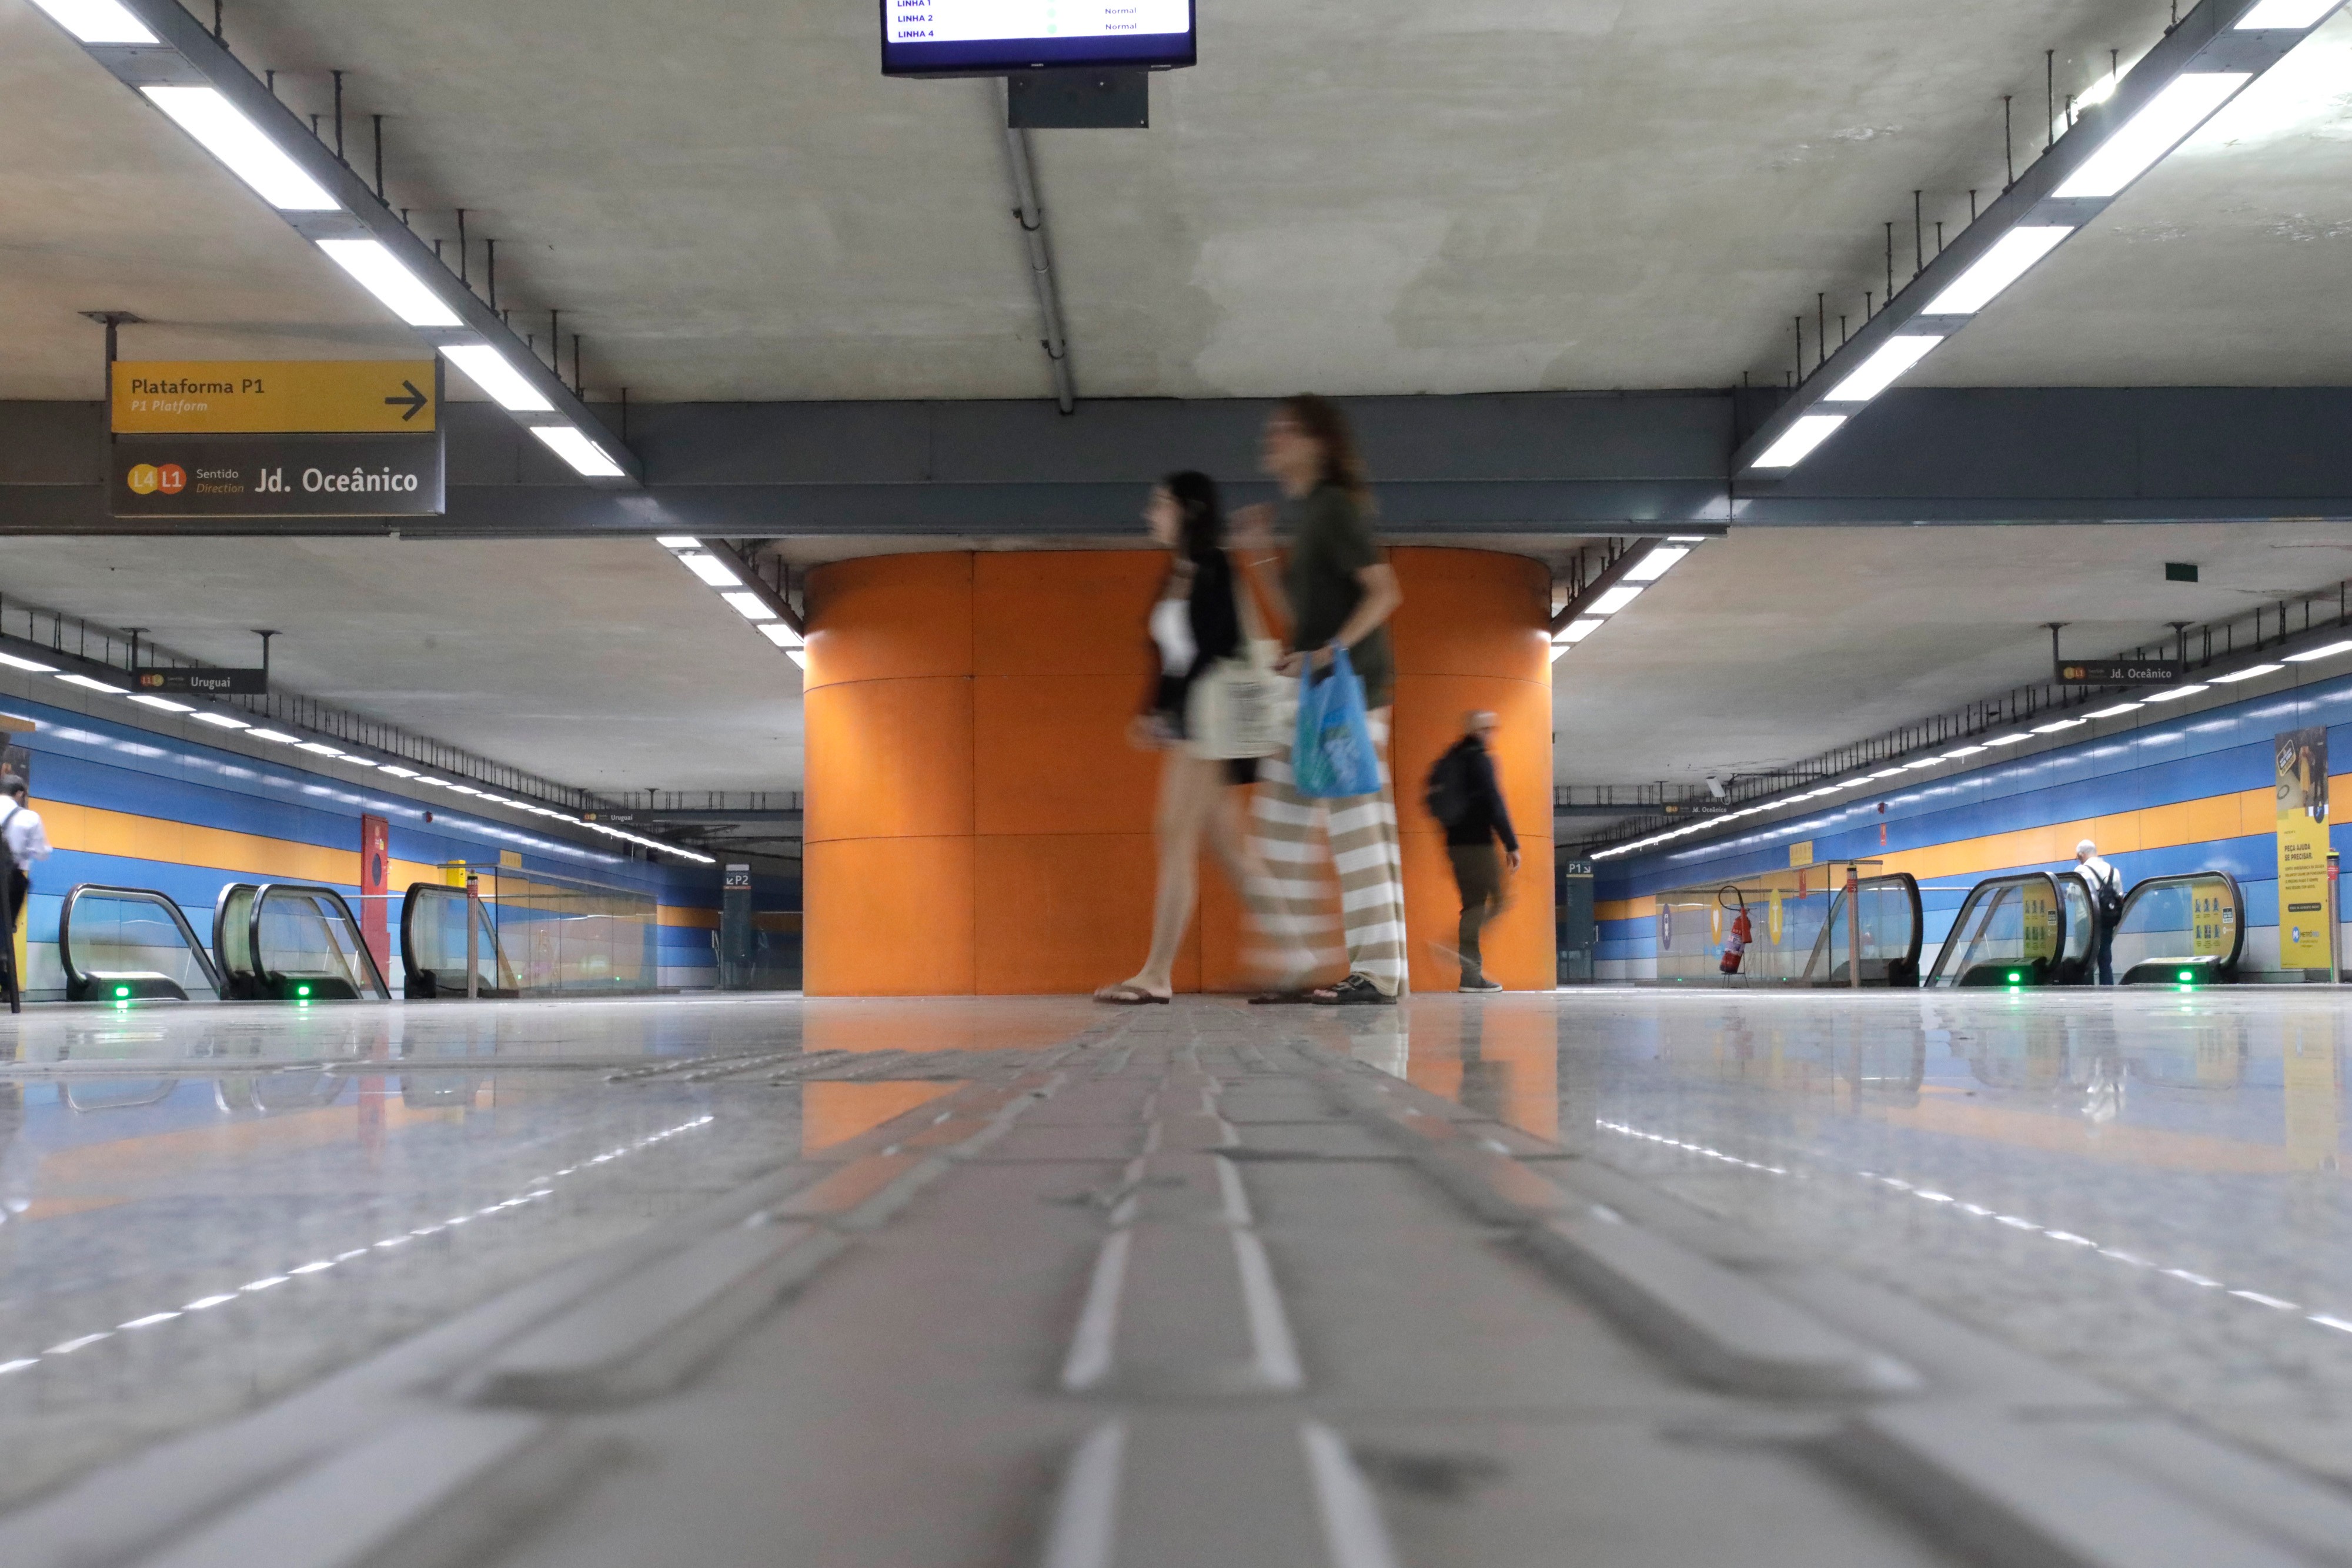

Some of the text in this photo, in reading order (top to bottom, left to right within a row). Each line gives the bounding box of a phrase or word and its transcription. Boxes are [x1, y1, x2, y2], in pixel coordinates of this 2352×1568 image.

[132, 378, 265, 394] Plataforma P1
[131, 399, 208, 414] P1 Platform
[134, 470, 182, 488] L4 L1
[196, 469, 239, 479] Sentido
[254, 467, 418, 492] Jd. Oceânico
[196, 483, 244, 493] Direction
[2110, 668, 2172, 678] Jd. Oceânico
[191, 677, 230, 690] Uruguai
[1569, 864, 1581, 873] P1
[736, 875, 749, 885] P2
